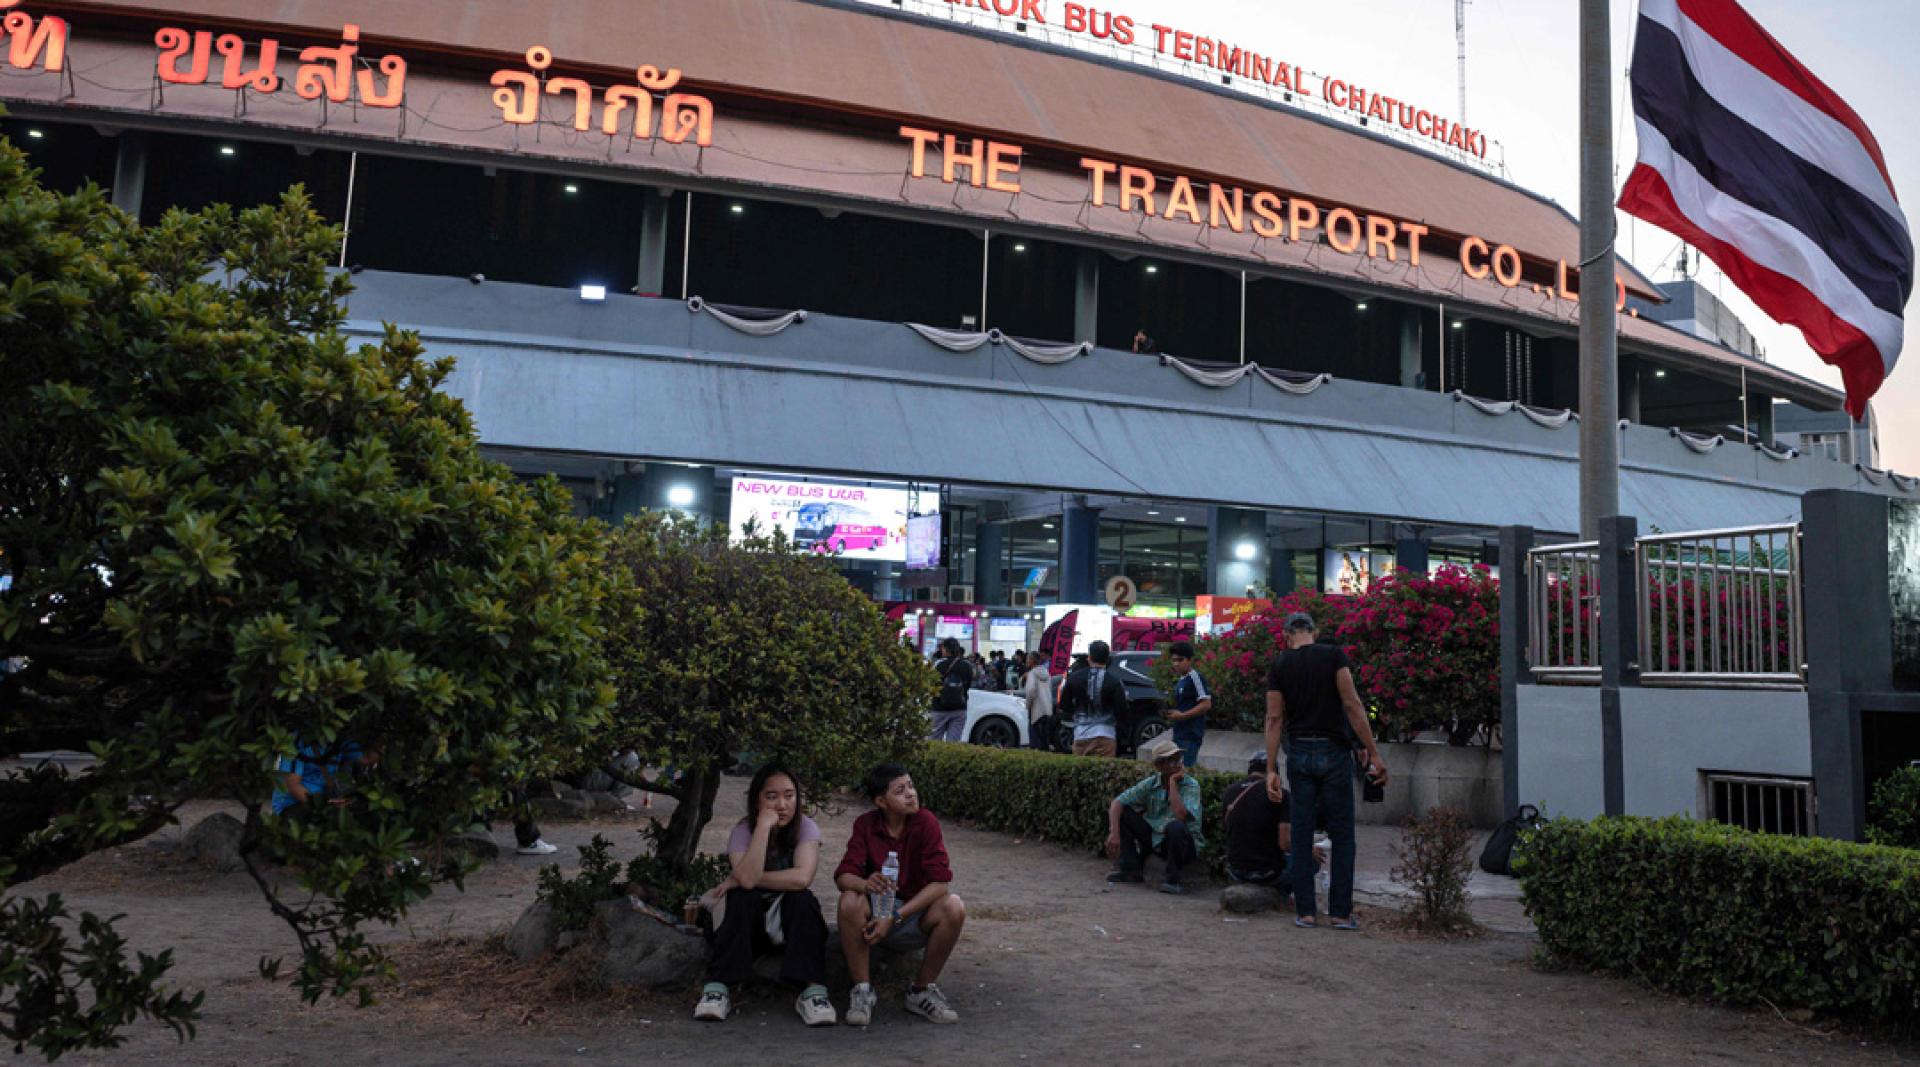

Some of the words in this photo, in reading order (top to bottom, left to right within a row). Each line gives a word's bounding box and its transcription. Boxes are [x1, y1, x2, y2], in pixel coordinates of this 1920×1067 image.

[155, 23, 407, 108] ขนส่ง
[490, 45, 714, 147] จำกัด
[1064, 1, 1135, 45] BUS
[1151, 23, 1310, 96] TERMINAL
[1322, 75, 1487, 160] (CHATUCHAK)
[900, 126, 1022, 194] THE
[1081, 157, 1429, 266] TRANSPORT
[737, 481, 784, 495] NEW
[787, 485, 824, 499] BUS
[1114, 580, 1130, 608] 2
